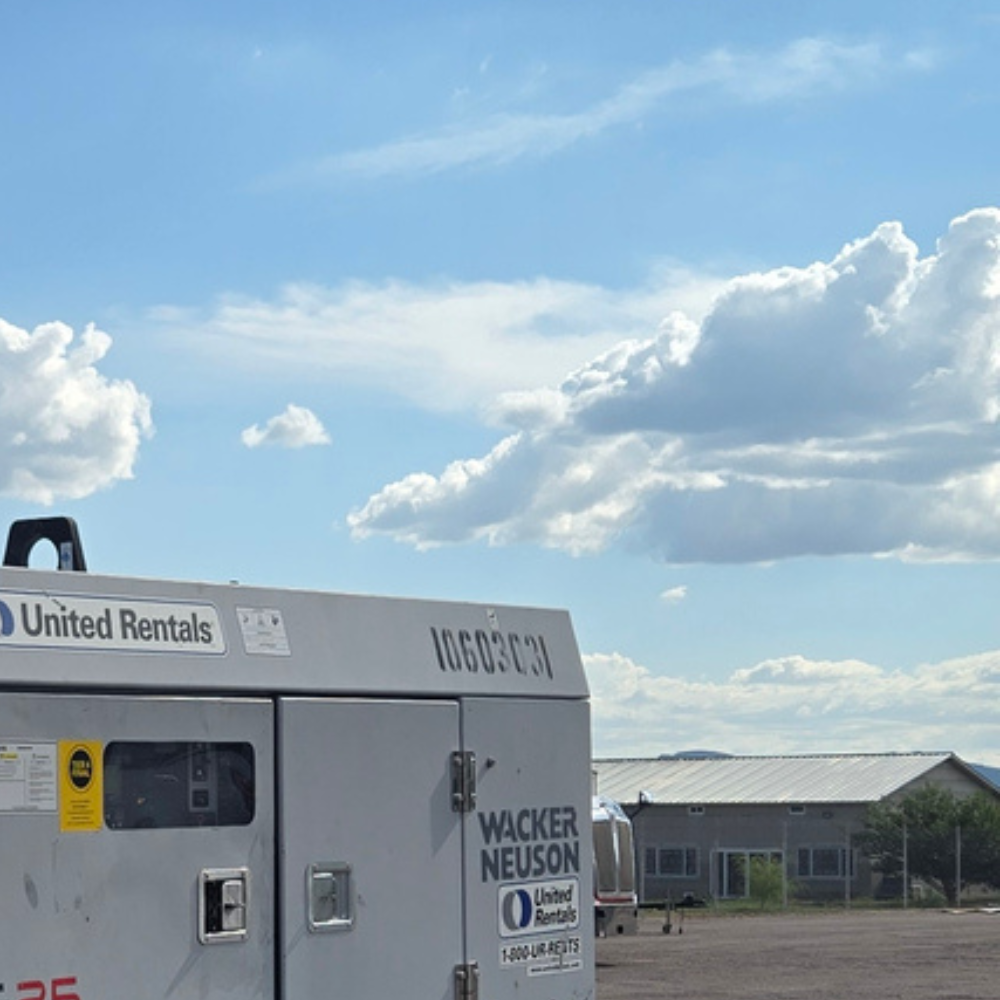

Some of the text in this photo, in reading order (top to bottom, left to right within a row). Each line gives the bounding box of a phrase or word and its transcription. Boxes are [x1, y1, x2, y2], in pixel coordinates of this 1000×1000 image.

[20, 602, 212, 644] United Rentals
[478, 806, 579, 845] WACKER
[481, 840, 580, 883] NEUSON
[534, 884, 574, 907] United
[534, 904, 577, 926] Rentals
